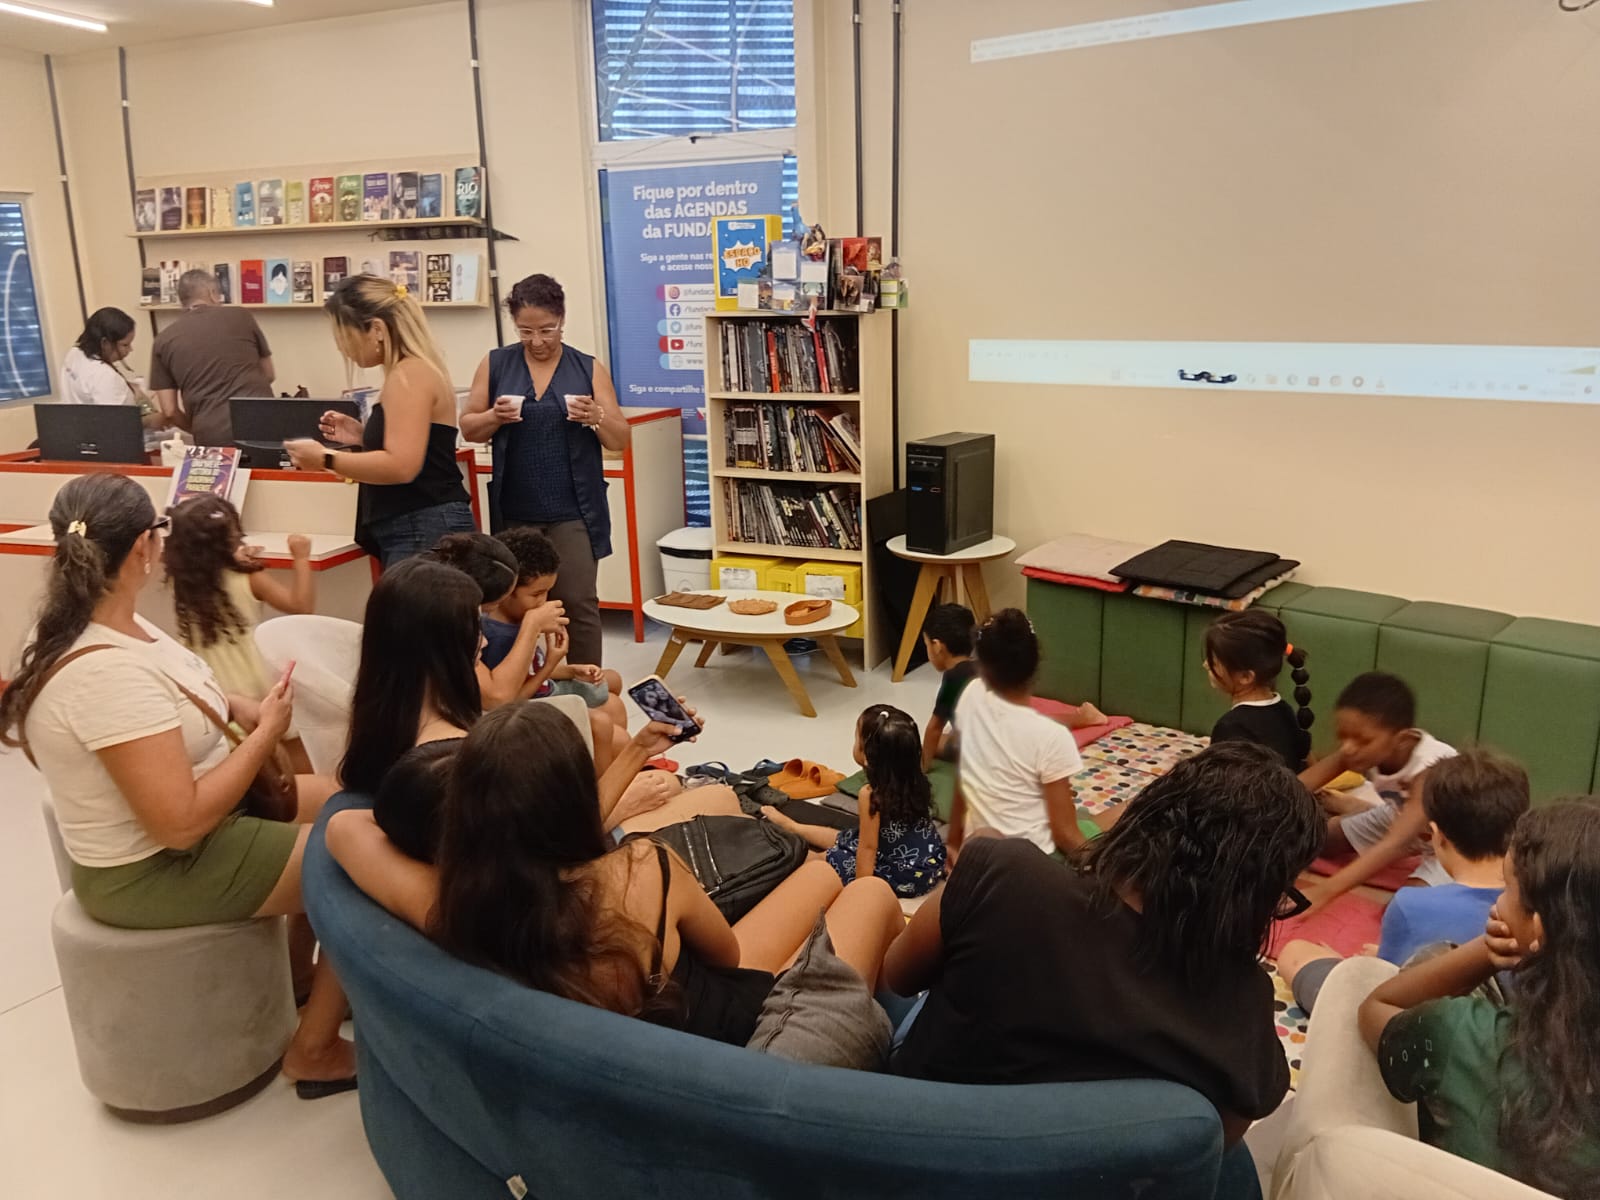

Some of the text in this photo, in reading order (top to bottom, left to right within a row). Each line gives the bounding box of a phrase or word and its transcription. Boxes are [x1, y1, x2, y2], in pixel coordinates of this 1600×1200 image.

[633, 180, 758, 203] Fique por dentro
[644, 200, 748, 219] das AGENDAS
[642, 223, 662, 239] da
[640, 252, 658, 264] Siga
[665, 254, 689, 263] gente
[629, 384, 647, 394] Siga
[654, 384, 700, 395] compartilhe
